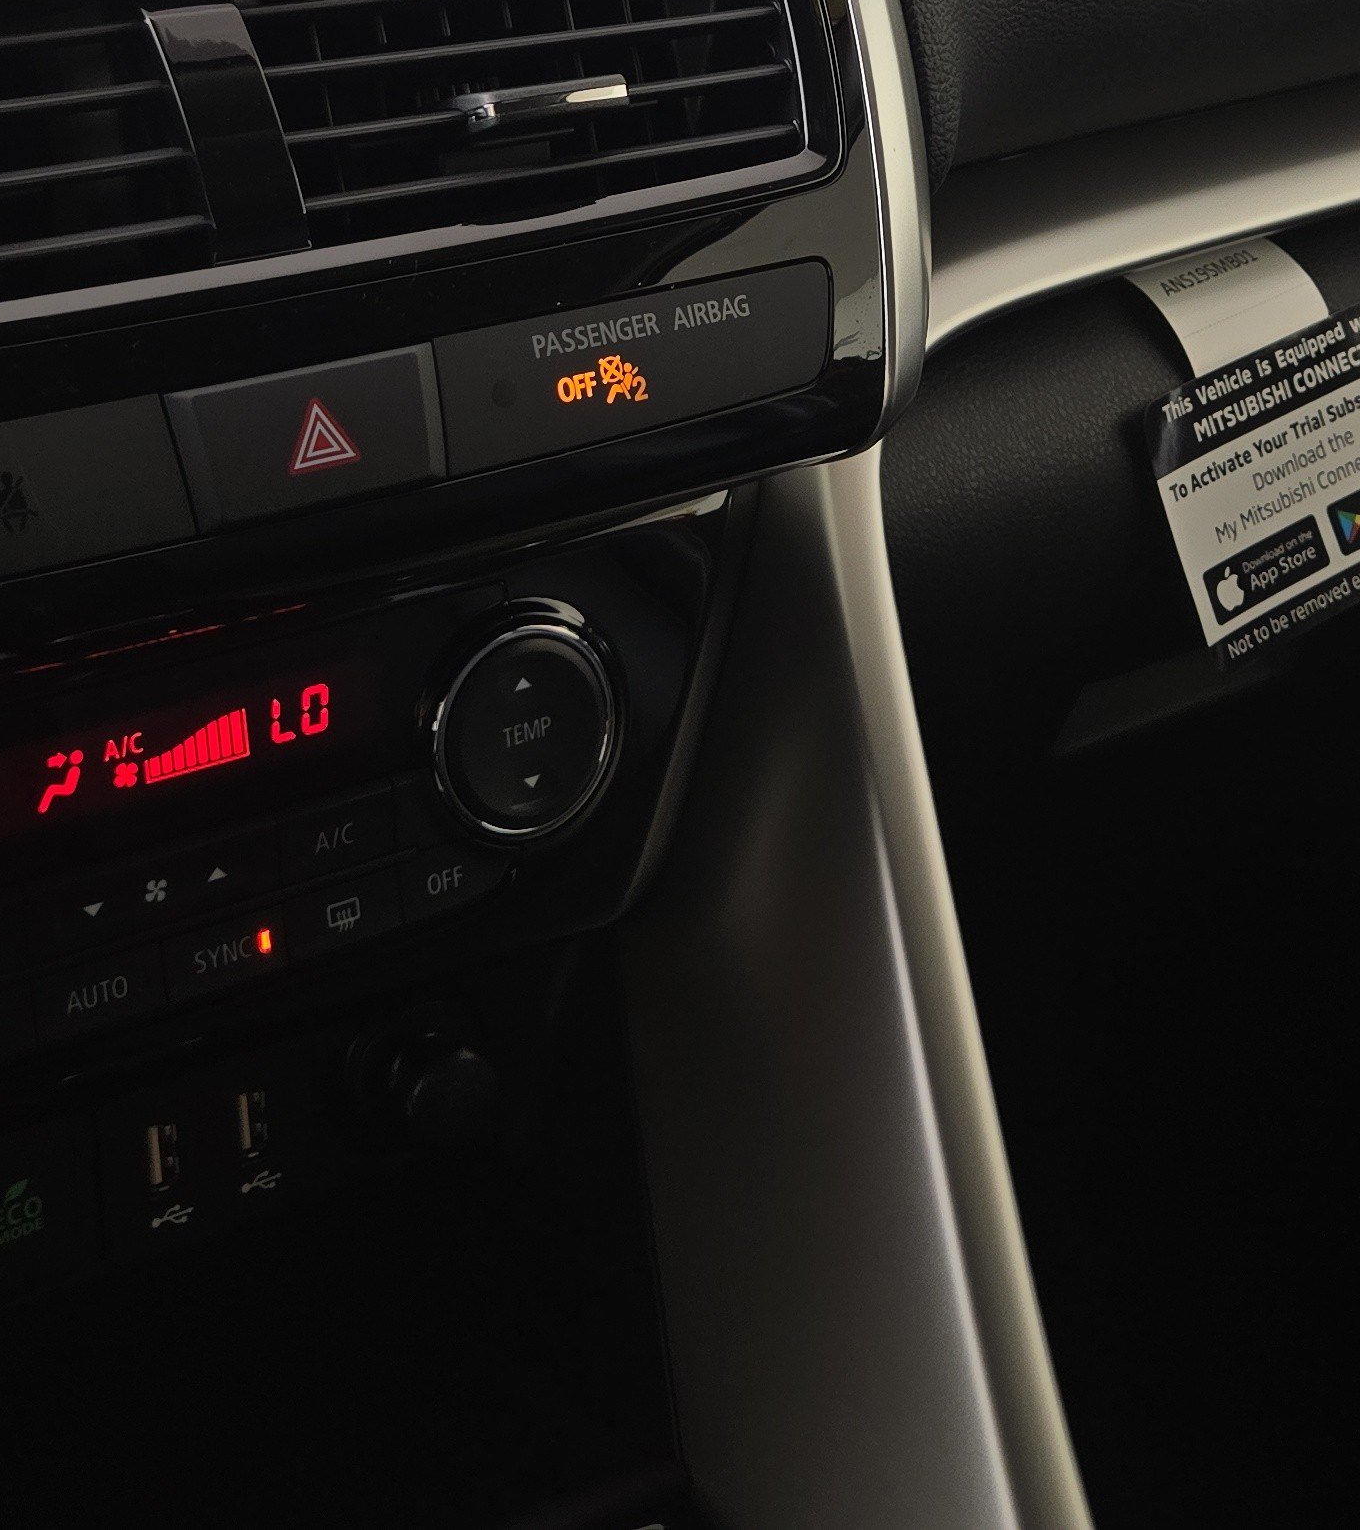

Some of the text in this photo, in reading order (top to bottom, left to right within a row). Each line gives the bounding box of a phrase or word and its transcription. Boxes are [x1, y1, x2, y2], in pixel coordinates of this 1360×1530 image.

[532, 294, 750, 357] PASSENGER AIRBAG
[557, 371, 596, 402] OFF
[1161, 396, 1193, 423] This
[1195, 368, 1252, 404] Vehicle
[1254, 358, 1272, 377] is
[1274, 321, 1345, 367] Equipped
[1193, 380, 1291, 441] MITSUBISHI
[1168, 482, 1188, 501] To
[1190, 450, 1252, 492] Activate
[1252, 431, 1287, 457] Your
[1289, 409, 1325, 439] Trial
[1252, 430, 1354, 490] Download the
[1214, 520, 1237, 543] My
[1239, 477, 1315, 529] Mitsubishi
[1250, 546, 1316, 590] App Store
[1227, 633, 1253, 658] Not
[1252, 625, 1269, 643] to
[1269, 614, 1289, 633] be
[1290, 578, 1350, 621] removed
[104, 730, 143, 762] A/C
[501, 714, 552, 750] TEMP
[315, 822, 355, 853] A/C
[425, 864, 464, 898] OFF
[193, 935, 253, 976] SYNC
[65, 974, 130, 1017] AUTO
